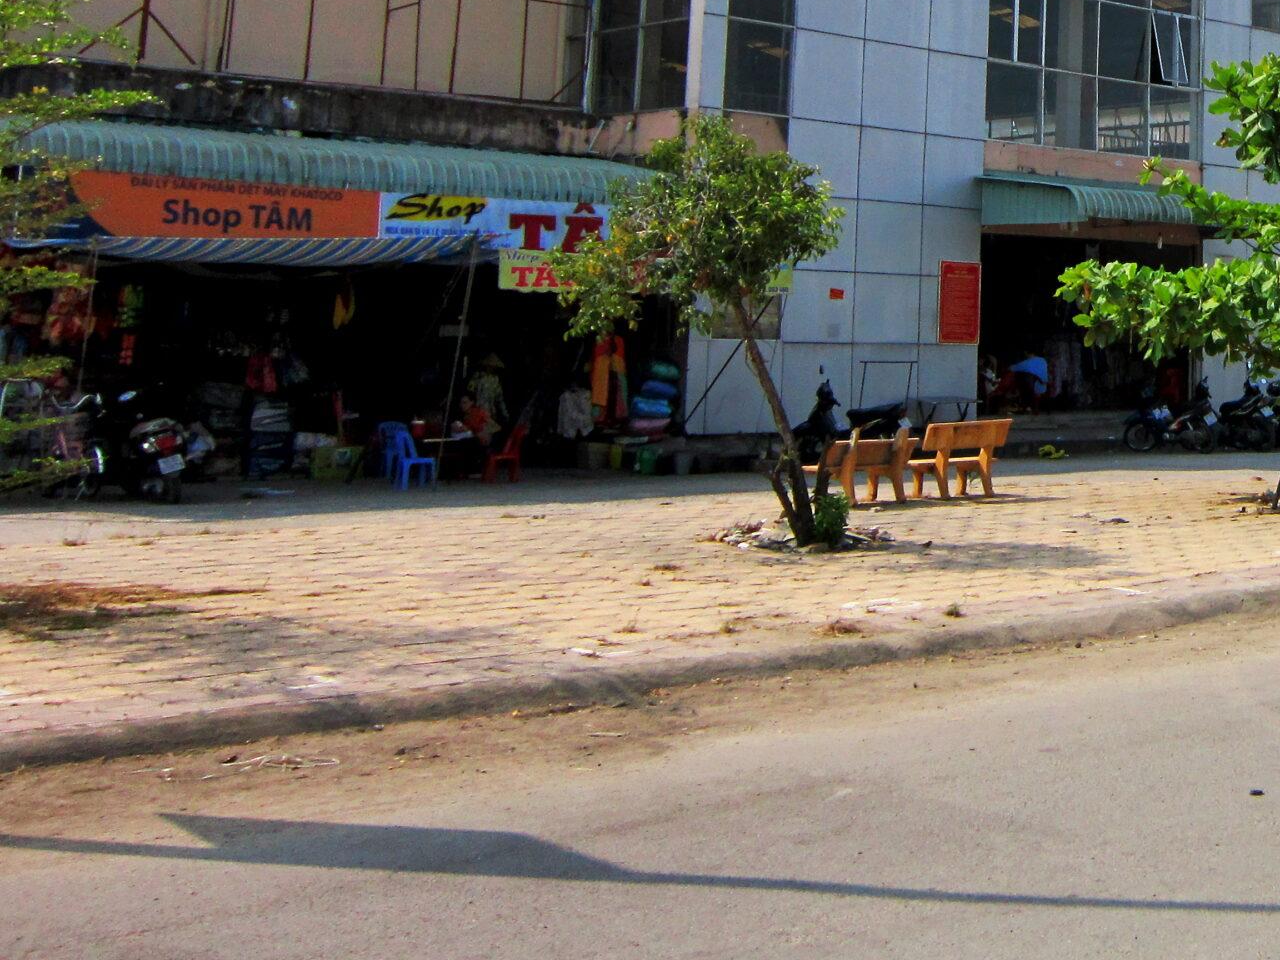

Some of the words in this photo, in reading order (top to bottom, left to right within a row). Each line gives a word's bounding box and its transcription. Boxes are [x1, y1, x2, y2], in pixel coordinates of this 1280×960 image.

[162, 199, 241, 233] Shop
[248, 201, 312, 231] TÂM
[386, 193, 488, 224] Shop
[509, 202, 604, 253] TÂ
[511, 262, 576, 288] TÂ
